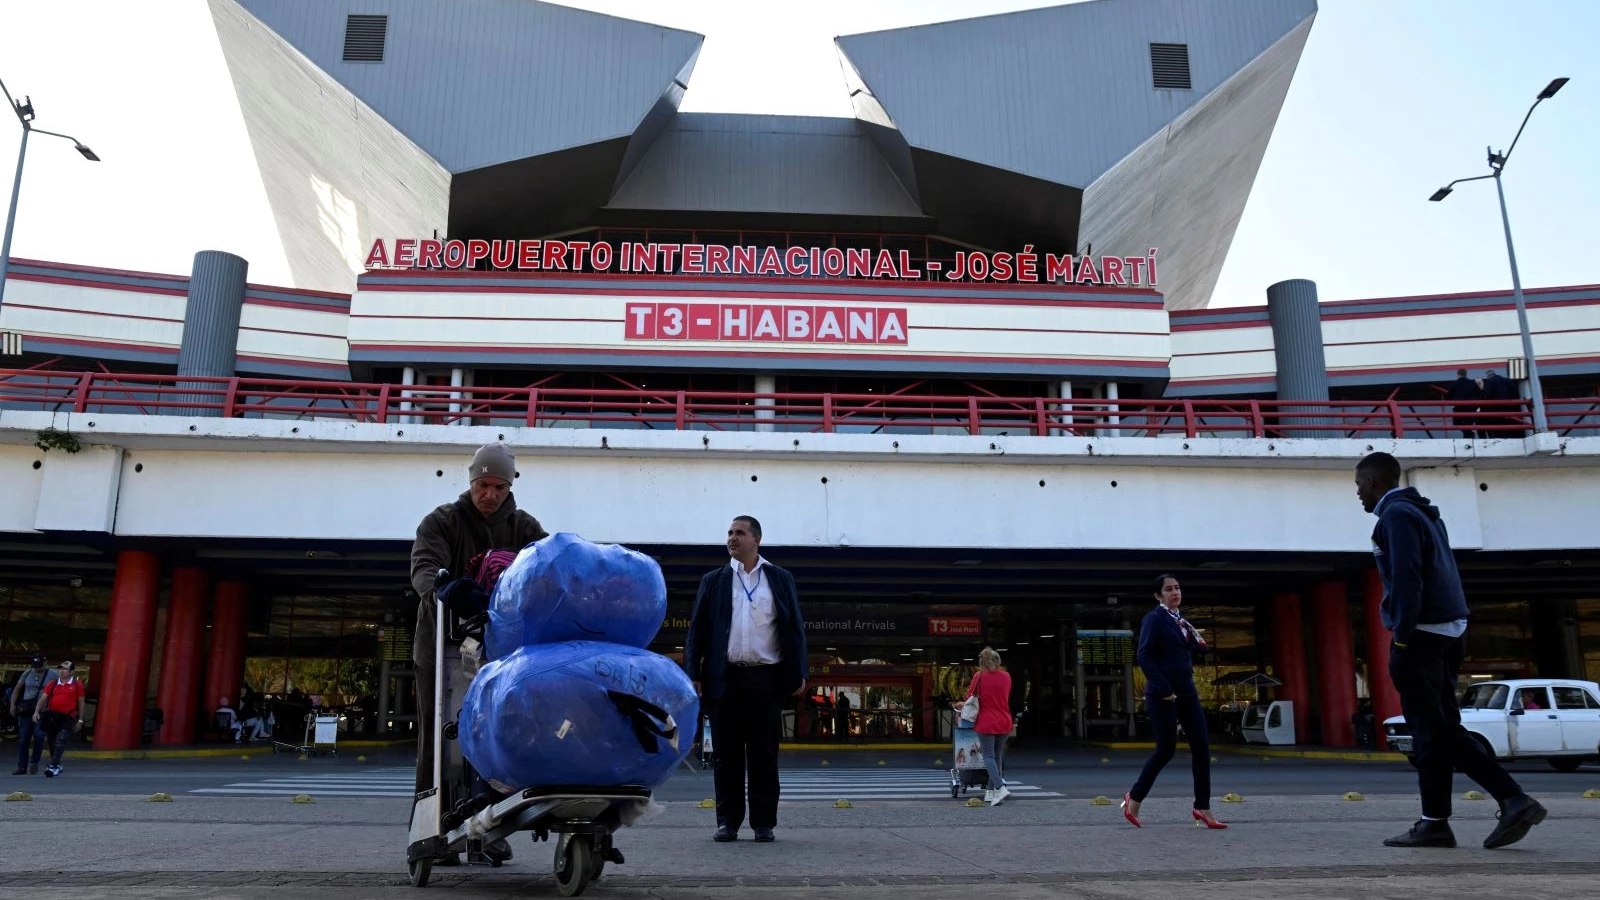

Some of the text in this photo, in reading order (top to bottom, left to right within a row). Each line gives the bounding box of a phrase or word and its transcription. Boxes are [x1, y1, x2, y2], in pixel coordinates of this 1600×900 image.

[365, 238, 613, 271] AEROPUERTO
[619, 242, 921, 279] INTERNACIONAL
[946, 244, 1038, 282] JOSÉ
[1046, 248, 1159, 285] MARTÍ
[803, 619, 896, 630] rnational Arrivals
[930, 619, 948, 632] T3
